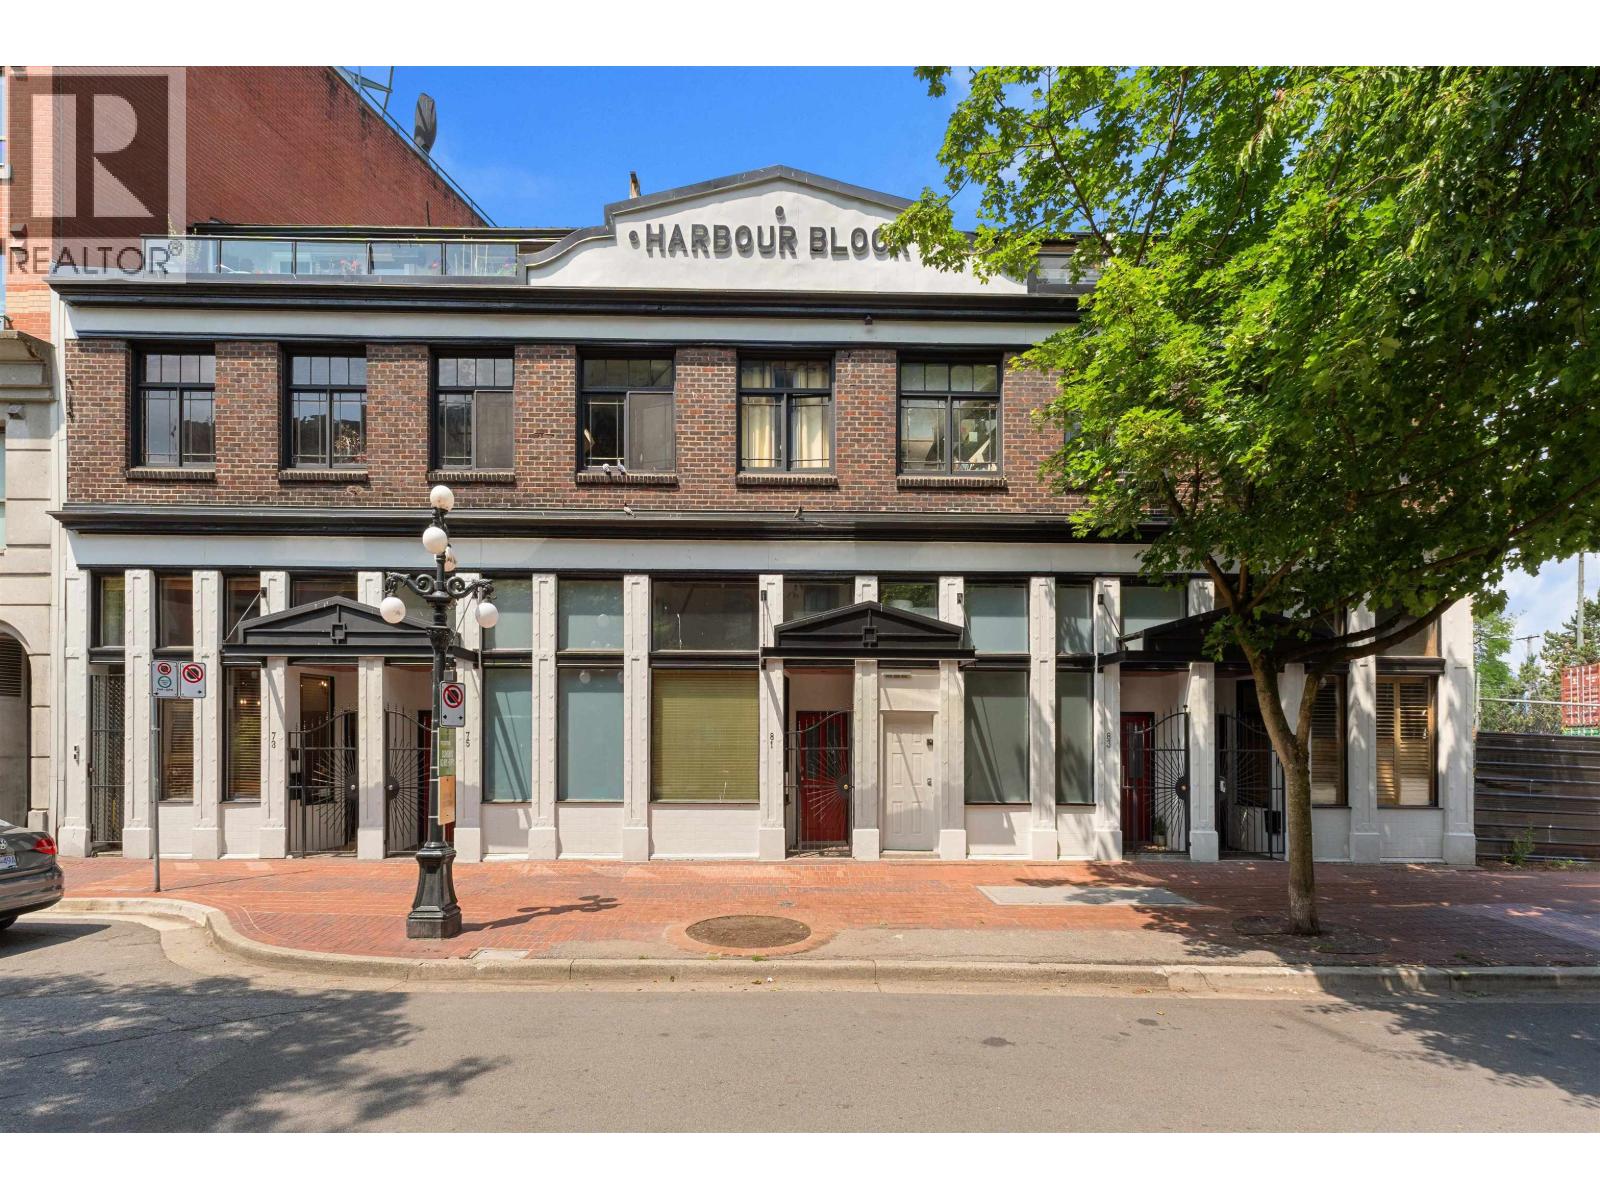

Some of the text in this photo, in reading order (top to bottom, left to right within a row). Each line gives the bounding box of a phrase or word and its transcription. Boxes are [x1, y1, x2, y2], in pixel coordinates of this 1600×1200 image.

[645, 223, 910, 256] HARBOUR BLOC
[271, 731, 276, 749] 73
[465, 731, 471, 748] 75
[769, 732, 775, 749] 81
